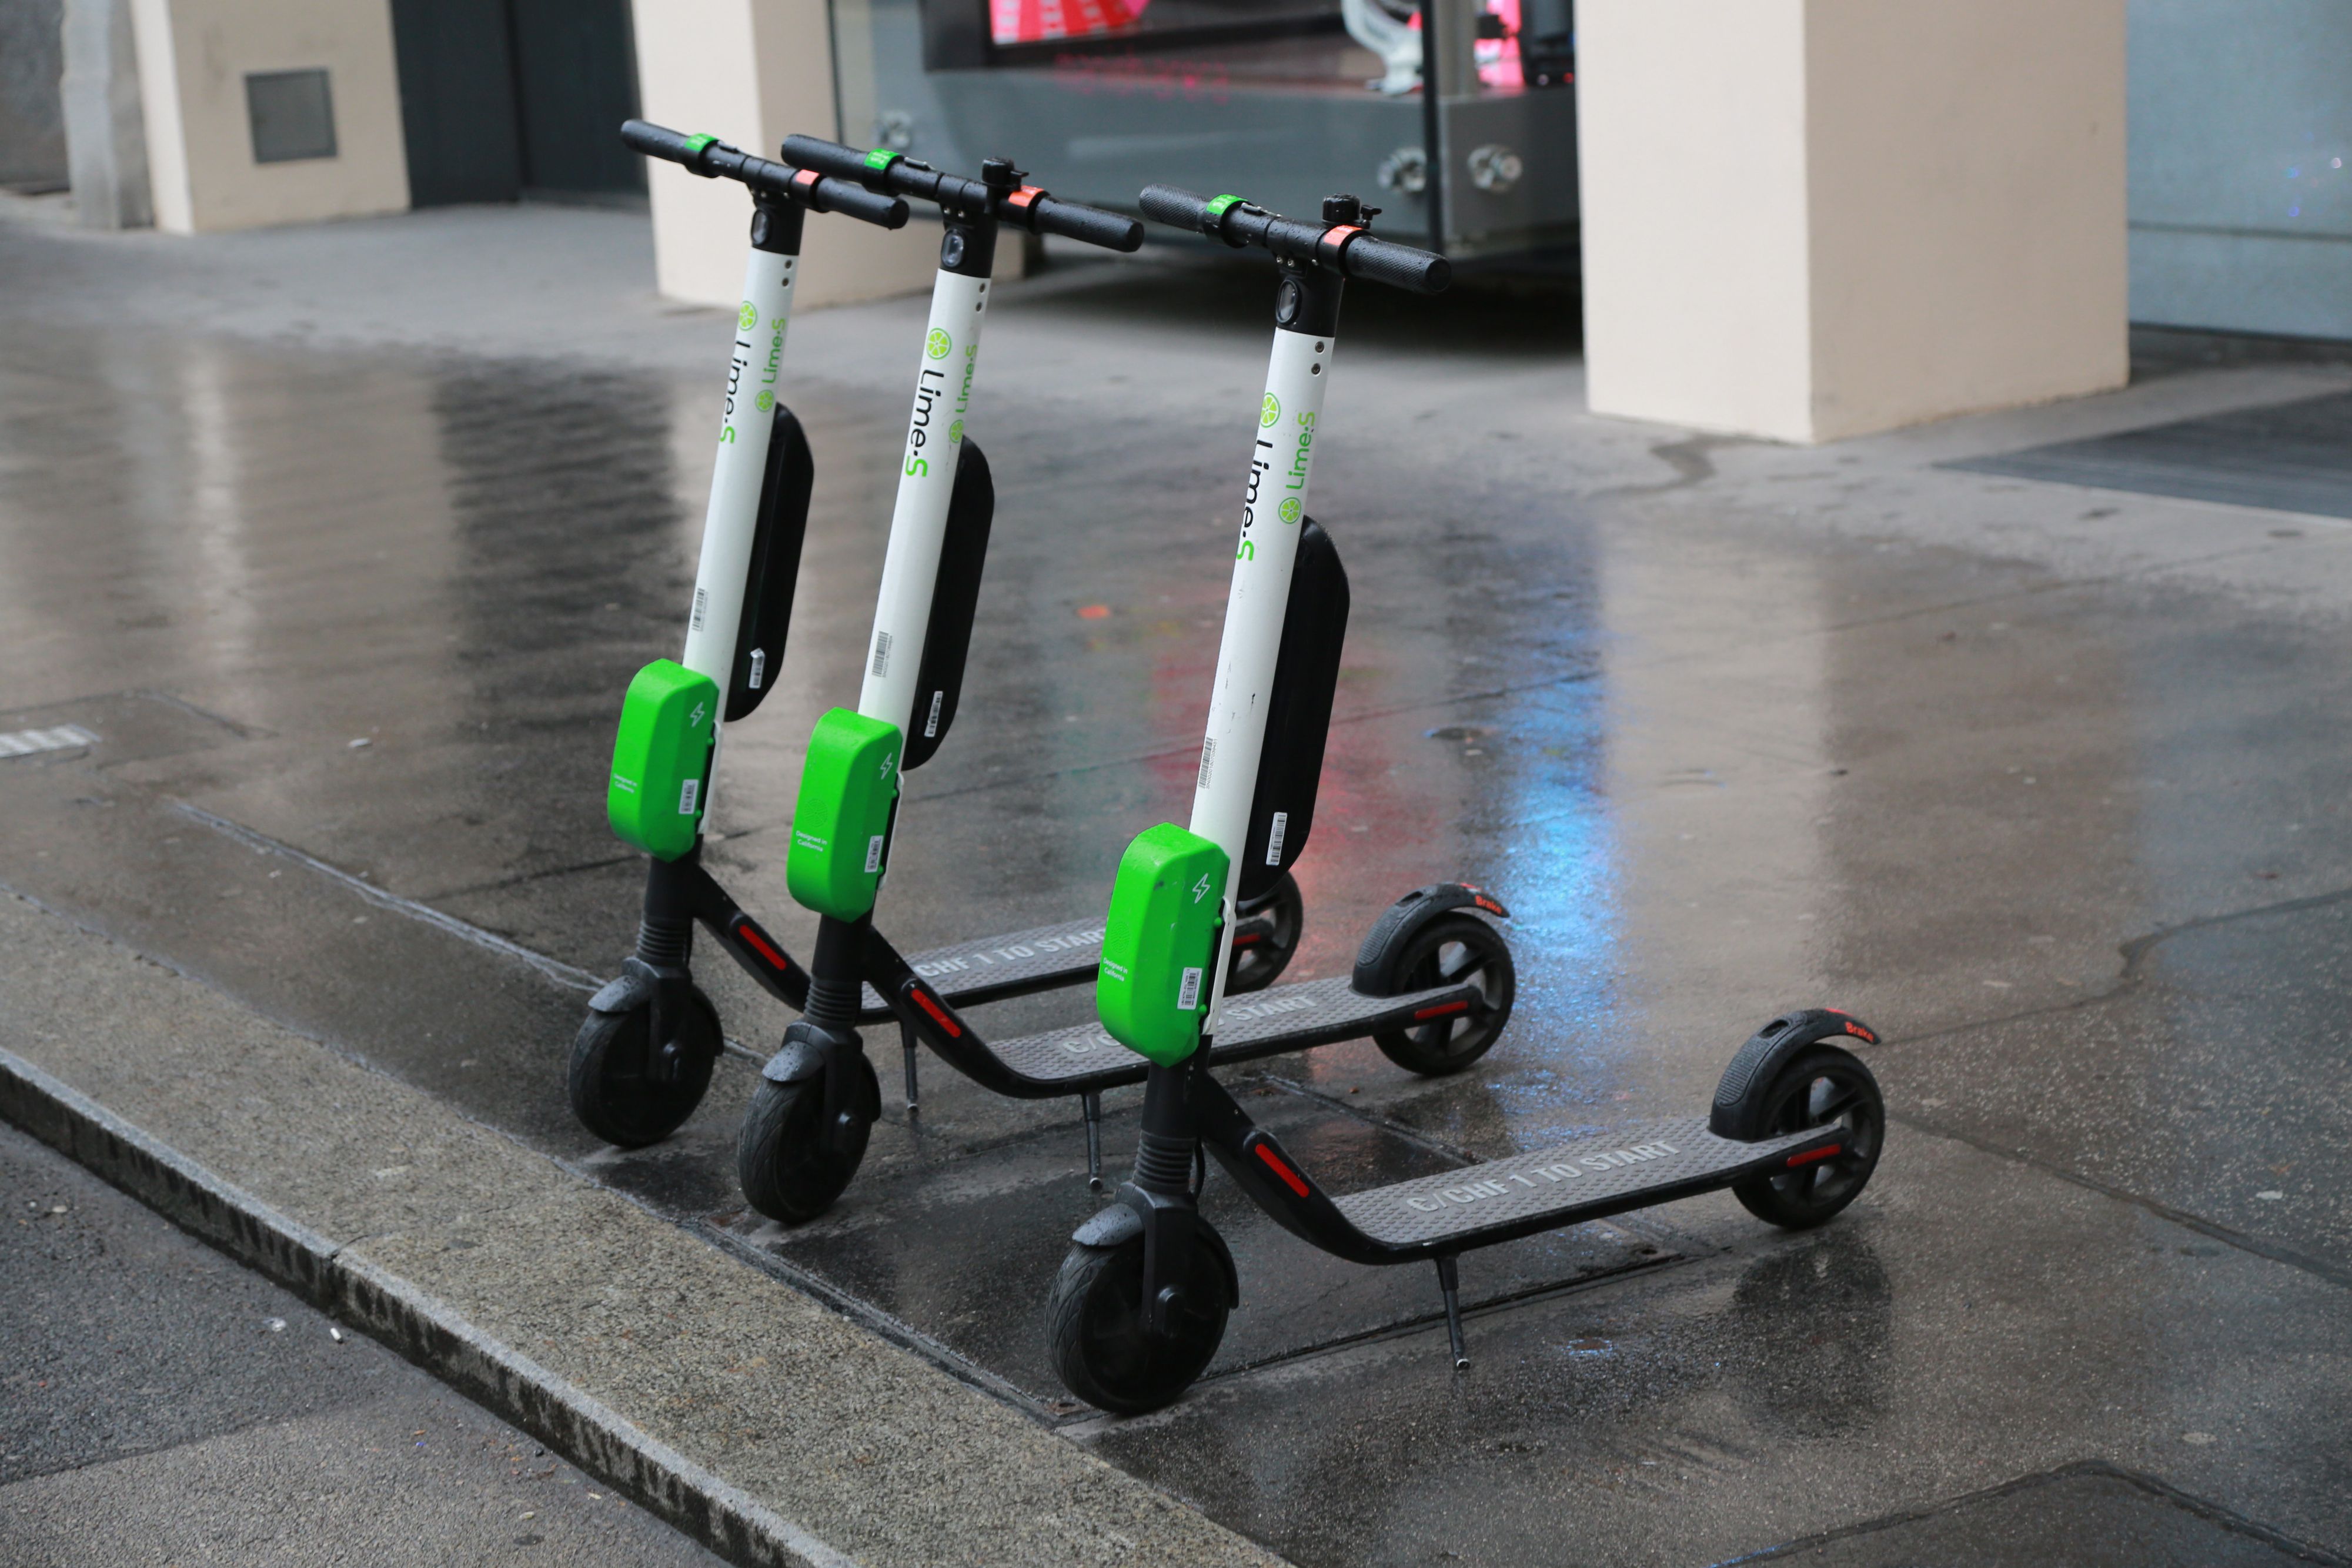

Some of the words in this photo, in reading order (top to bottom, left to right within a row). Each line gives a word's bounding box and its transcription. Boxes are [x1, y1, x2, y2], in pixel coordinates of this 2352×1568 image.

[796, 830, 821, 843] Designed
[797, 839, 823, 852] California
[1475, 895, 1502, 915] Brake
[972, 954, 994, 965] 1
[993, 945, 1035, 961] TO
[1103, 957, 1123, 972] Designed
[1104, 967, 1124, 982] California
[1226, 995, 1318, 1021] START
[1845, 1022, 1874, 1042] Brake
[1406, 1179, 1509, 1212] €/CHF
[1509, 1174, 1537, 1189] 1
[1532, 1163, 1583, 1183] TO
[1580, 1140, 1682, 1172] START
